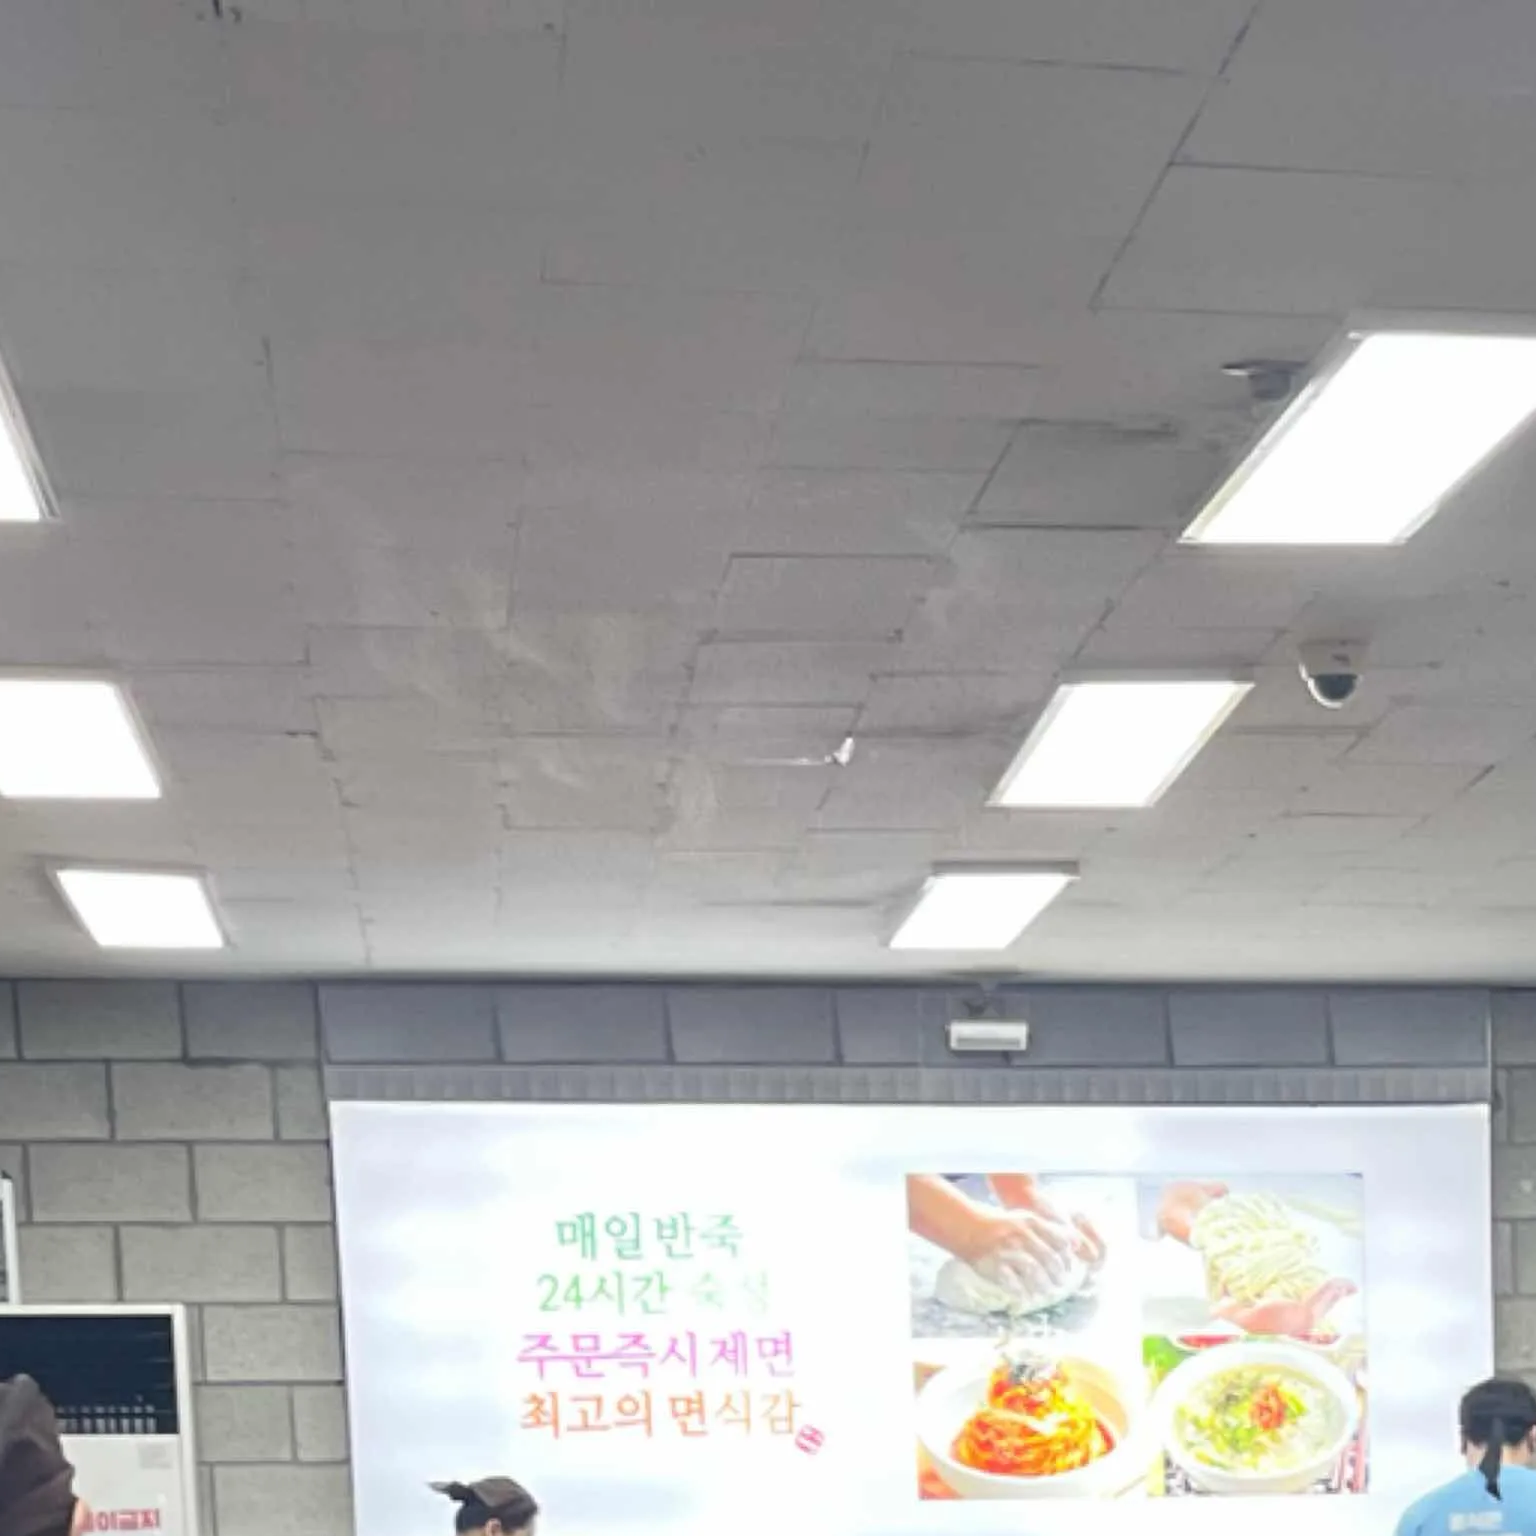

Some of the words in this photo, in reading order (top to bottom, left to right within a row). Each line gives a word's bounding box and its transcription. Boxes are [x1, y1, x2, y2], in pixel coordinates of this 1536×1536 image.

[556, 1211, 643, 1261] 매일
[655, 1211, 743, 1260] 반죽
[537, 1269, 669, 1317] 24시간
[517, 1330, 699, 1381] 주문즉시
[709, 1329, 797, 1379] 제면
[520, 1388, 654, 1439] 최고의
